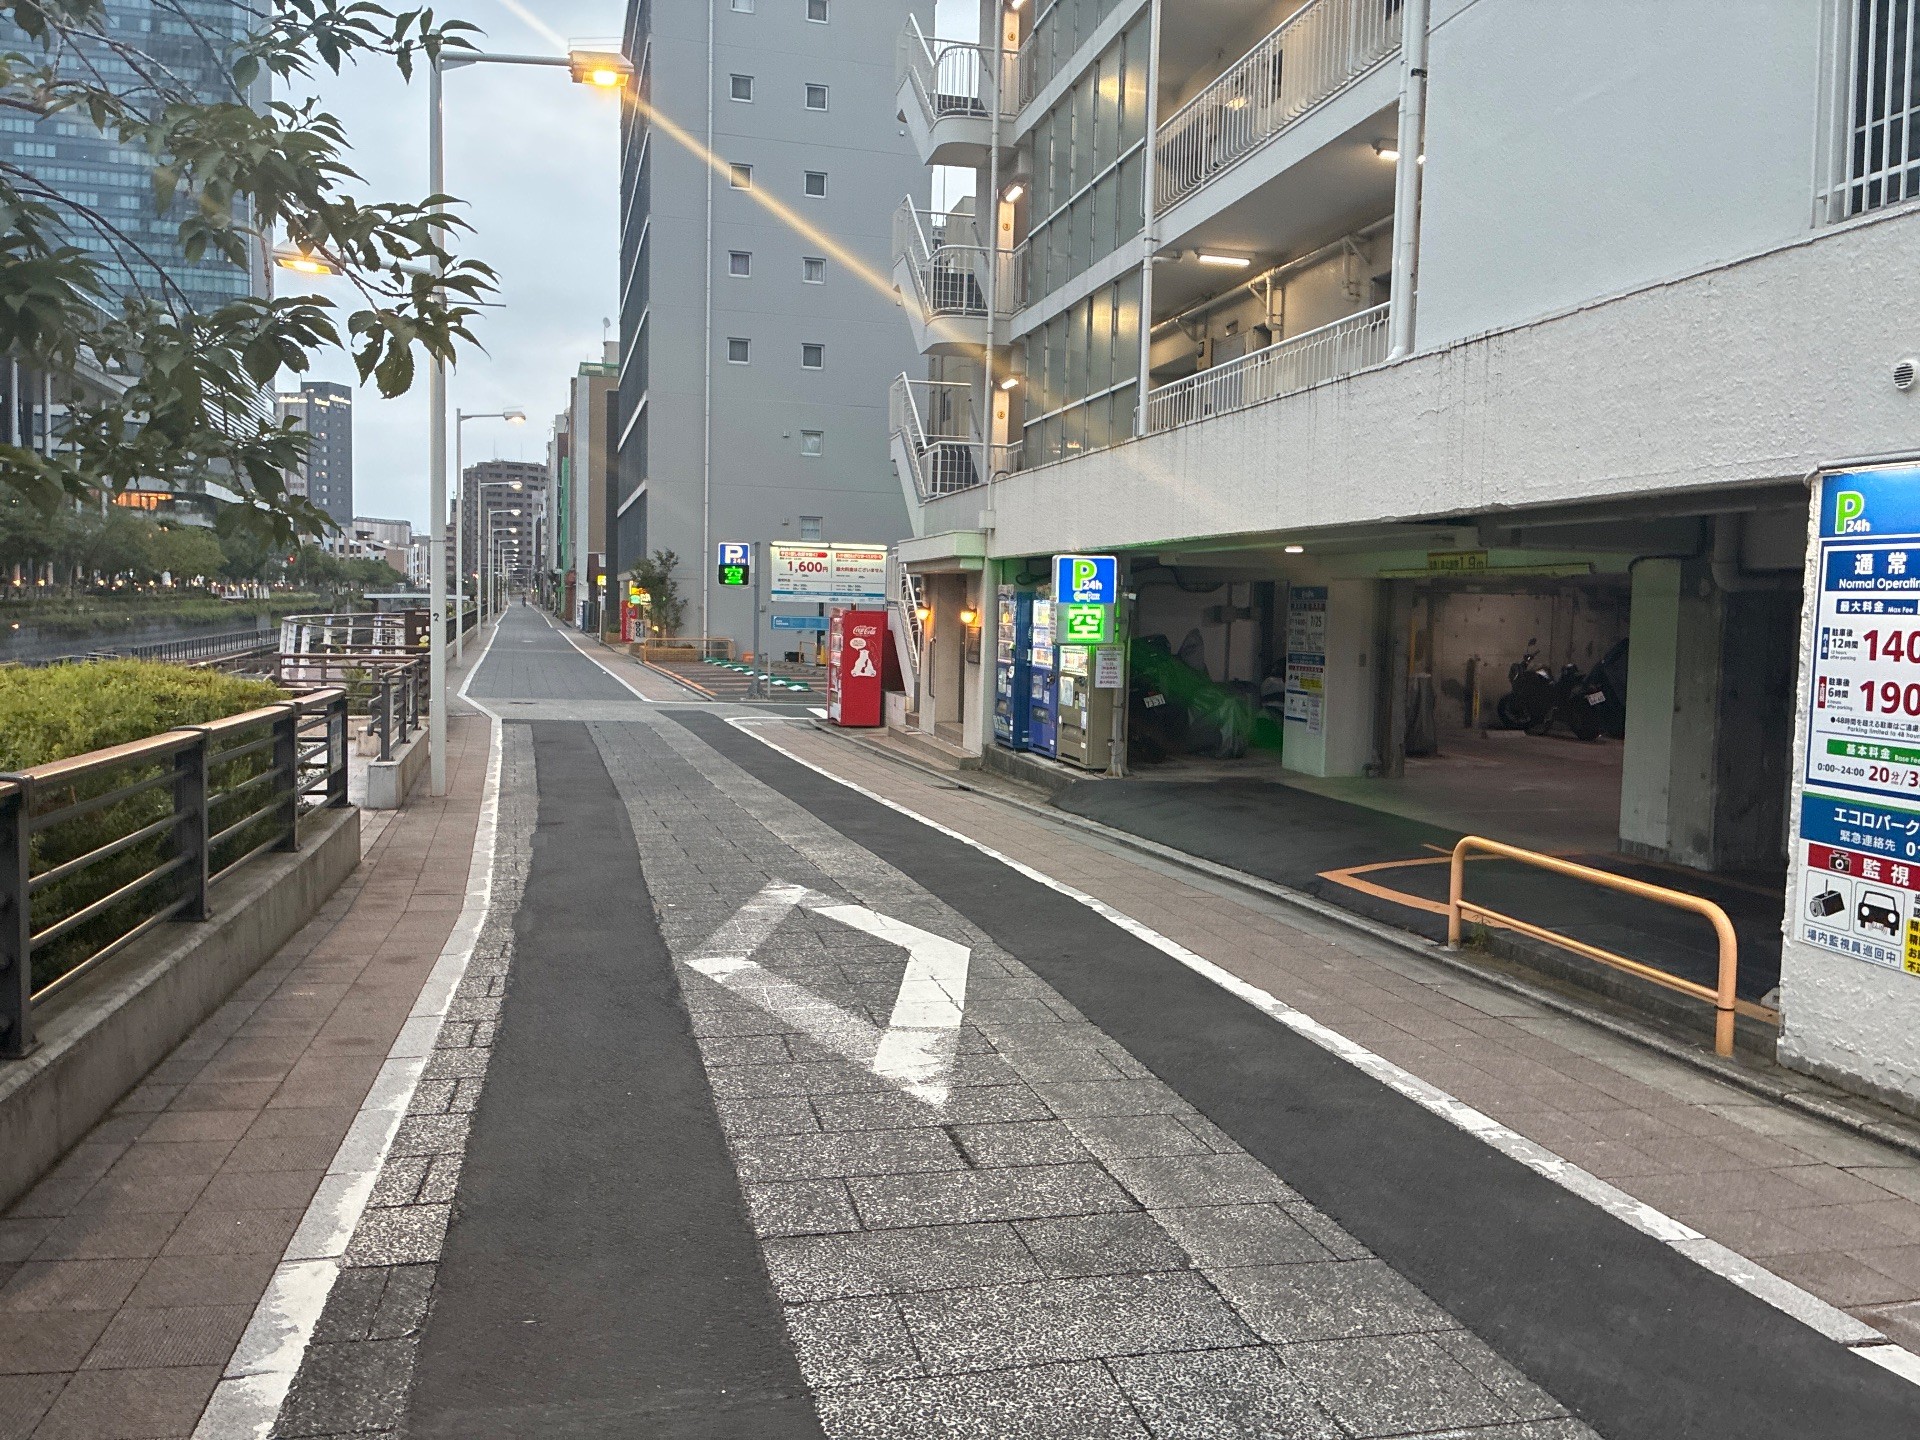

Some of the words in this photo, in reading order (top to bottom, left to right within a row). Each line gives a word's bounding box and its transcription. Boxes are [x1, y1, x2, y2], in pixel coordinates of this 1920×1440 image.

[1835, 491, 1865, 534] P
[1846, 518, 1871, 532] 24h
[725, 546, 744, 564] P
[1855, 552, 1908, 575] 通常
[724, 566, 743, 584] 空
[1072, 559, 1097, 591] P
[1839, 578, 1875, 589] Normal
[1083, 580, 1102, 590] 24h
[1840, 601, 1884, 613] 最大料金
[1068, 604, 1101, 638] 空
[1831, 628, 1853, 637] 駐車後
[1832, 639, 1859, 649] 12時間
[1829, 678, 1850, 687] 駐車後
[1828, 688, 1848, 698] 6時間
[1847, 726, 1868, 735] Parking
[1869, 728, 1888, 736] limited
[1846, 743, 1891, 760] 基本料金
[1894, 754, 1909, 762] Base
[1833, 807, 1919, 836] エコロパーク
[1839, 830, 1896, 852] 緊急連絡先
[1862, 858, 1909, 886] 監視
[1807, 929, 1896, 963] 場内監視員巡回中
